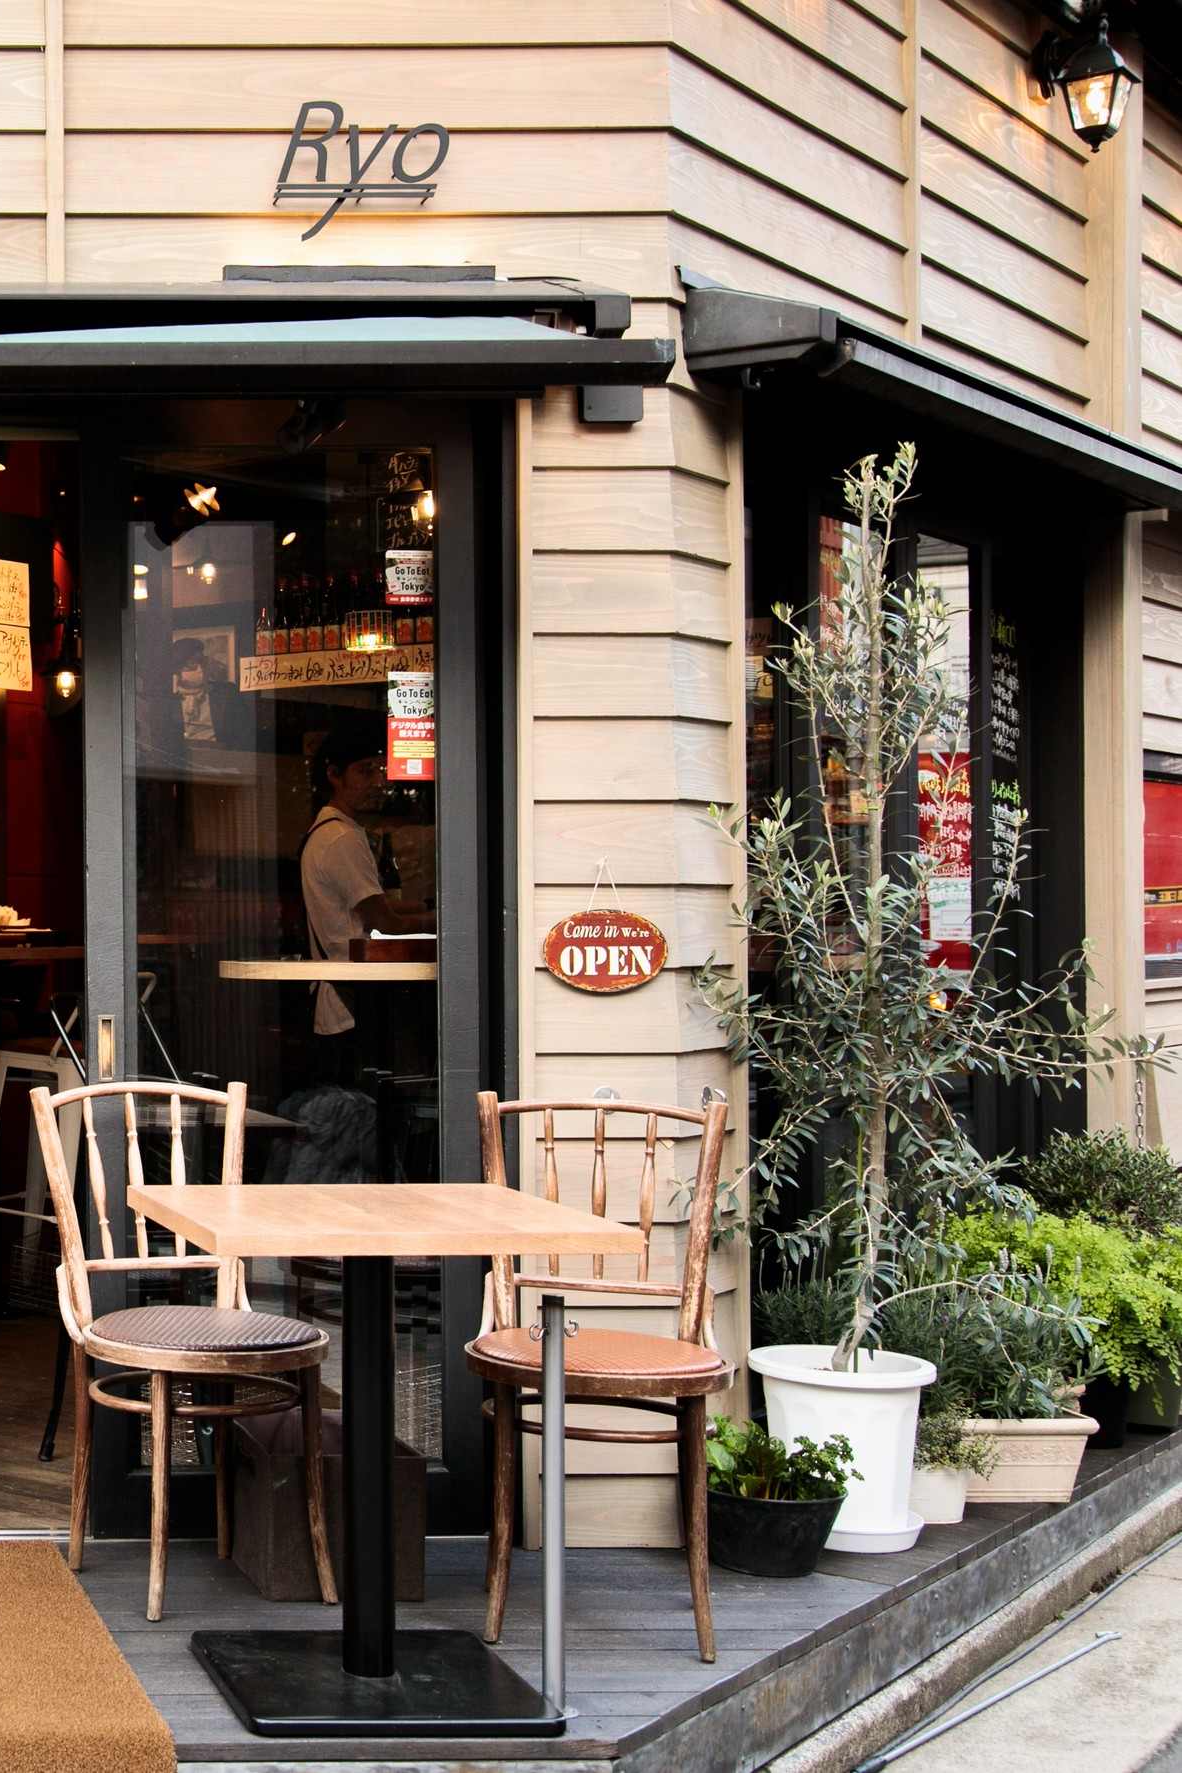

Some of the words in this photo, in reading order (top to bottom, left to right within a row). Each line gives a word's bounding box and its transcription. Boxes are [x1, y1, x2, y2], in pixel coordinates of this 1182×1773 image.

[275, 100, 450, 241] Ryo
[395, 566, 405, 576] Go
[406, 566, 416, 576] To
[416, 566, 430, 576] Eat
[400, 581, 425, 595] Tokyo
[304, 656, 324, 681] 680
[396, 688, 407, 698] Go
[409, 688, 418, 698] To
[419, 688, 434, 698] Eat
[403, 705, 428, 716] Tokyo
[563, 920, 602, 939] Come
[604, 920, 620, 938] in
[621, 927, 650, 938] We're
[559, 945, 654, 976] OPEN
